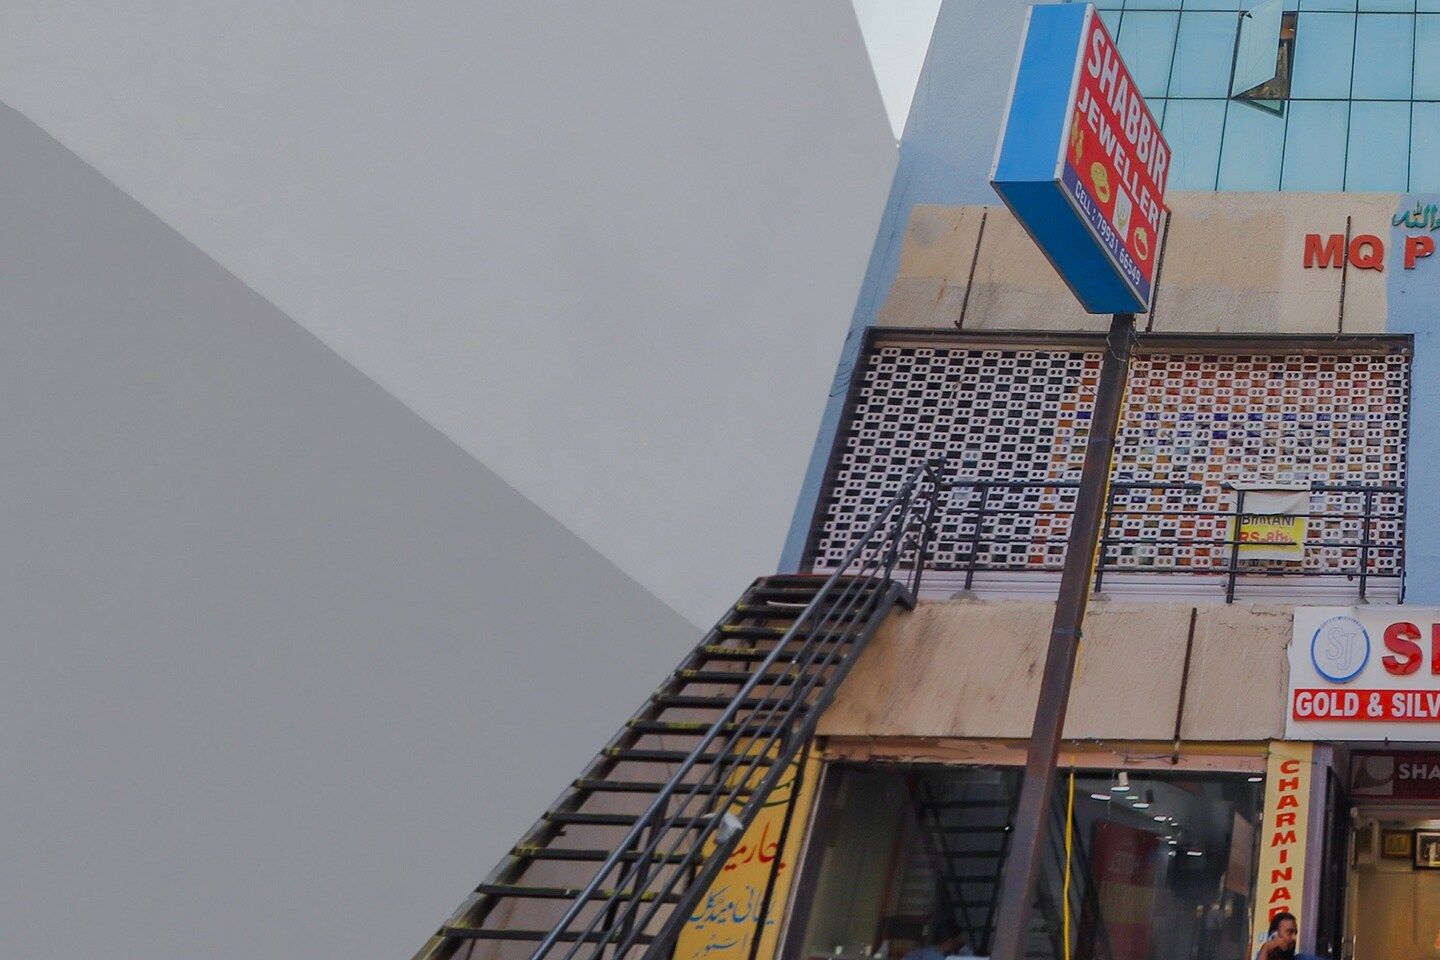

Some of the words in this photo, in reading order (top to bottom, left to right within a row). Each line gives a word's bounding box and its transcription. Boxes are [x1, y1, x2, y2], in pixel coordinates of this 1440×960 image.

[1087, 28, 1169, 194] SHABBIR
[1074, 181, 1092, 218] CELL
[1097, 215, 1118, 258] 79931
[1119, 249, 1141, 287] 66549
[1303, 234, 1384, 272] MQ
[1295, 691, 1357, 718] GOLD
[1366, 692, 1384, 718] &
